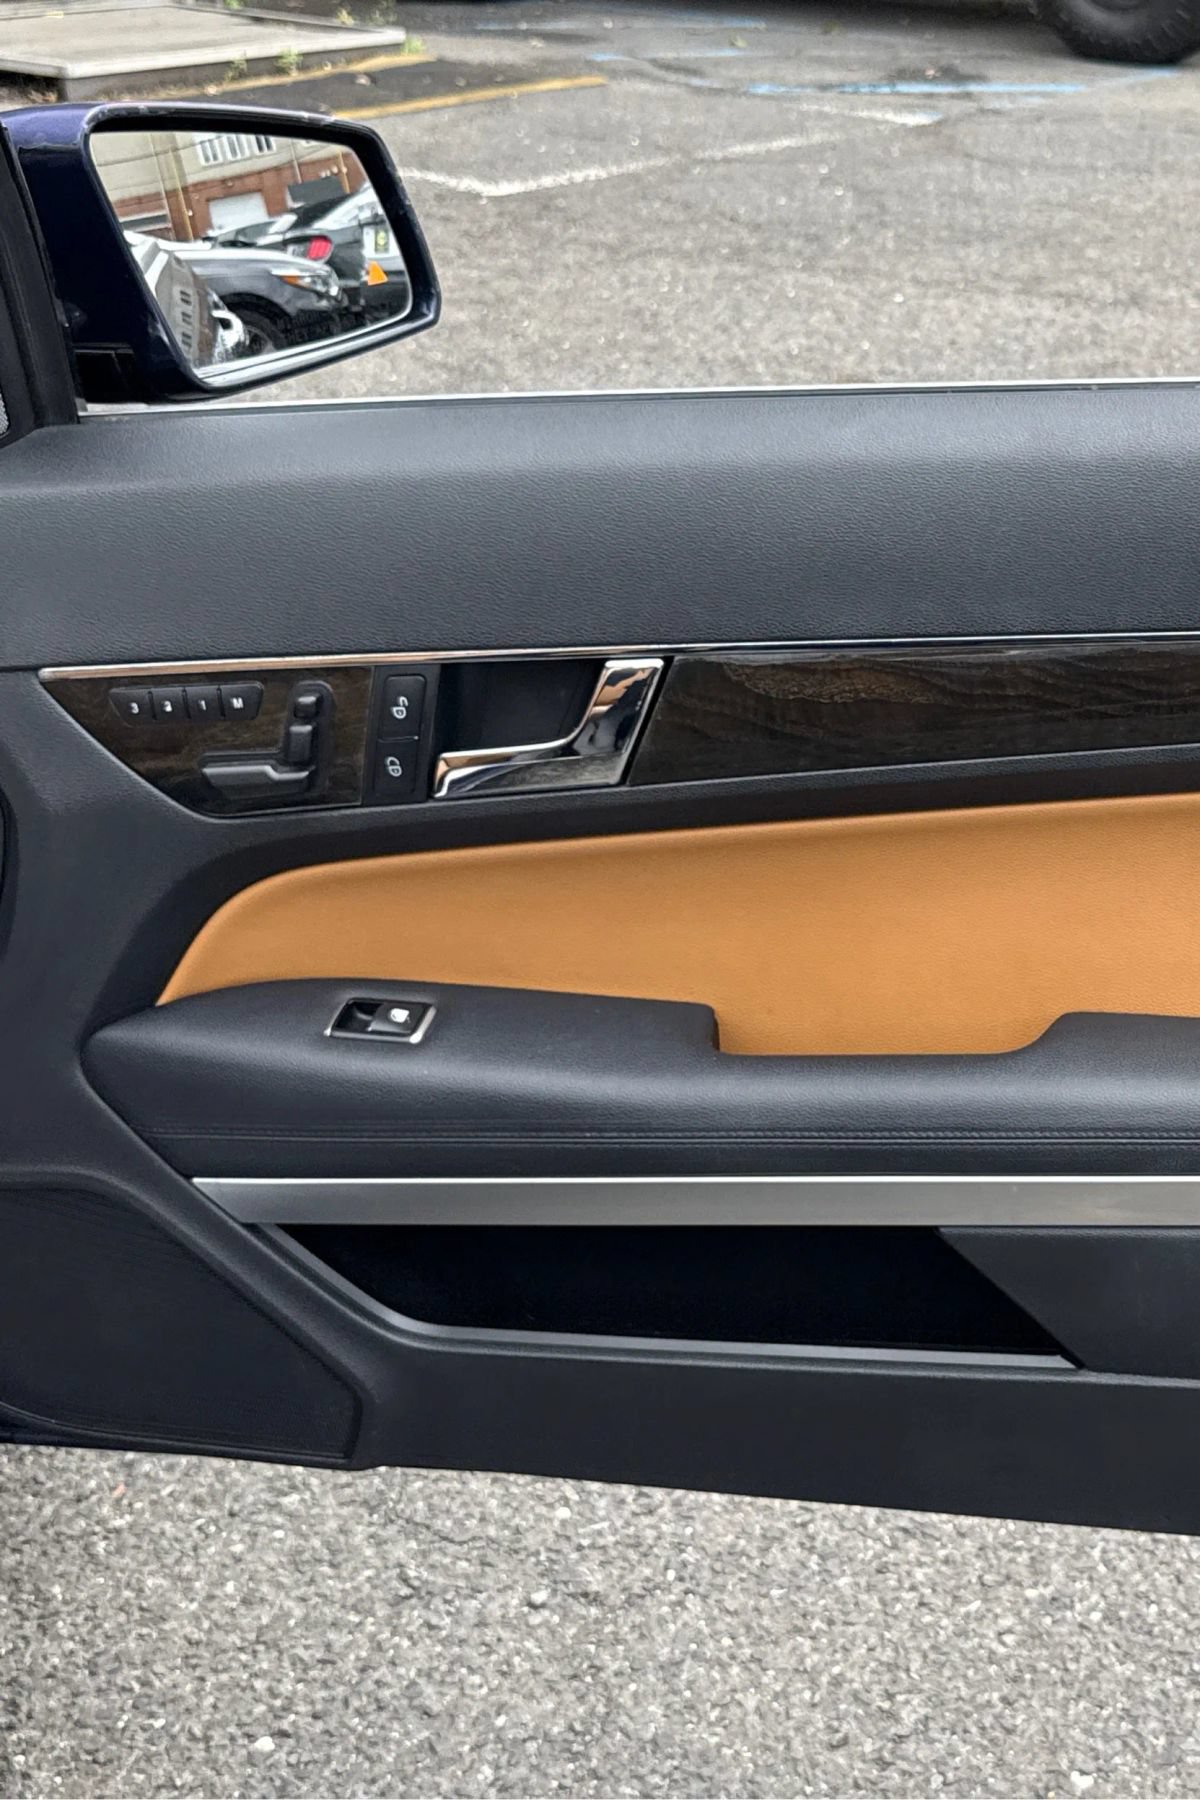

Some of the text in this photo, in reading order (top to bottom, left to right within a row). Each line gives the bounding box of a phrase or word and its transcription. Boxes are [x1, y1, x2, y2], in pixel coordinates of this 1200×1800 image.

[130, 702, 140, 715] 3
[198, 699, 207, 711] 1
[231, 697, 244, 710] M
